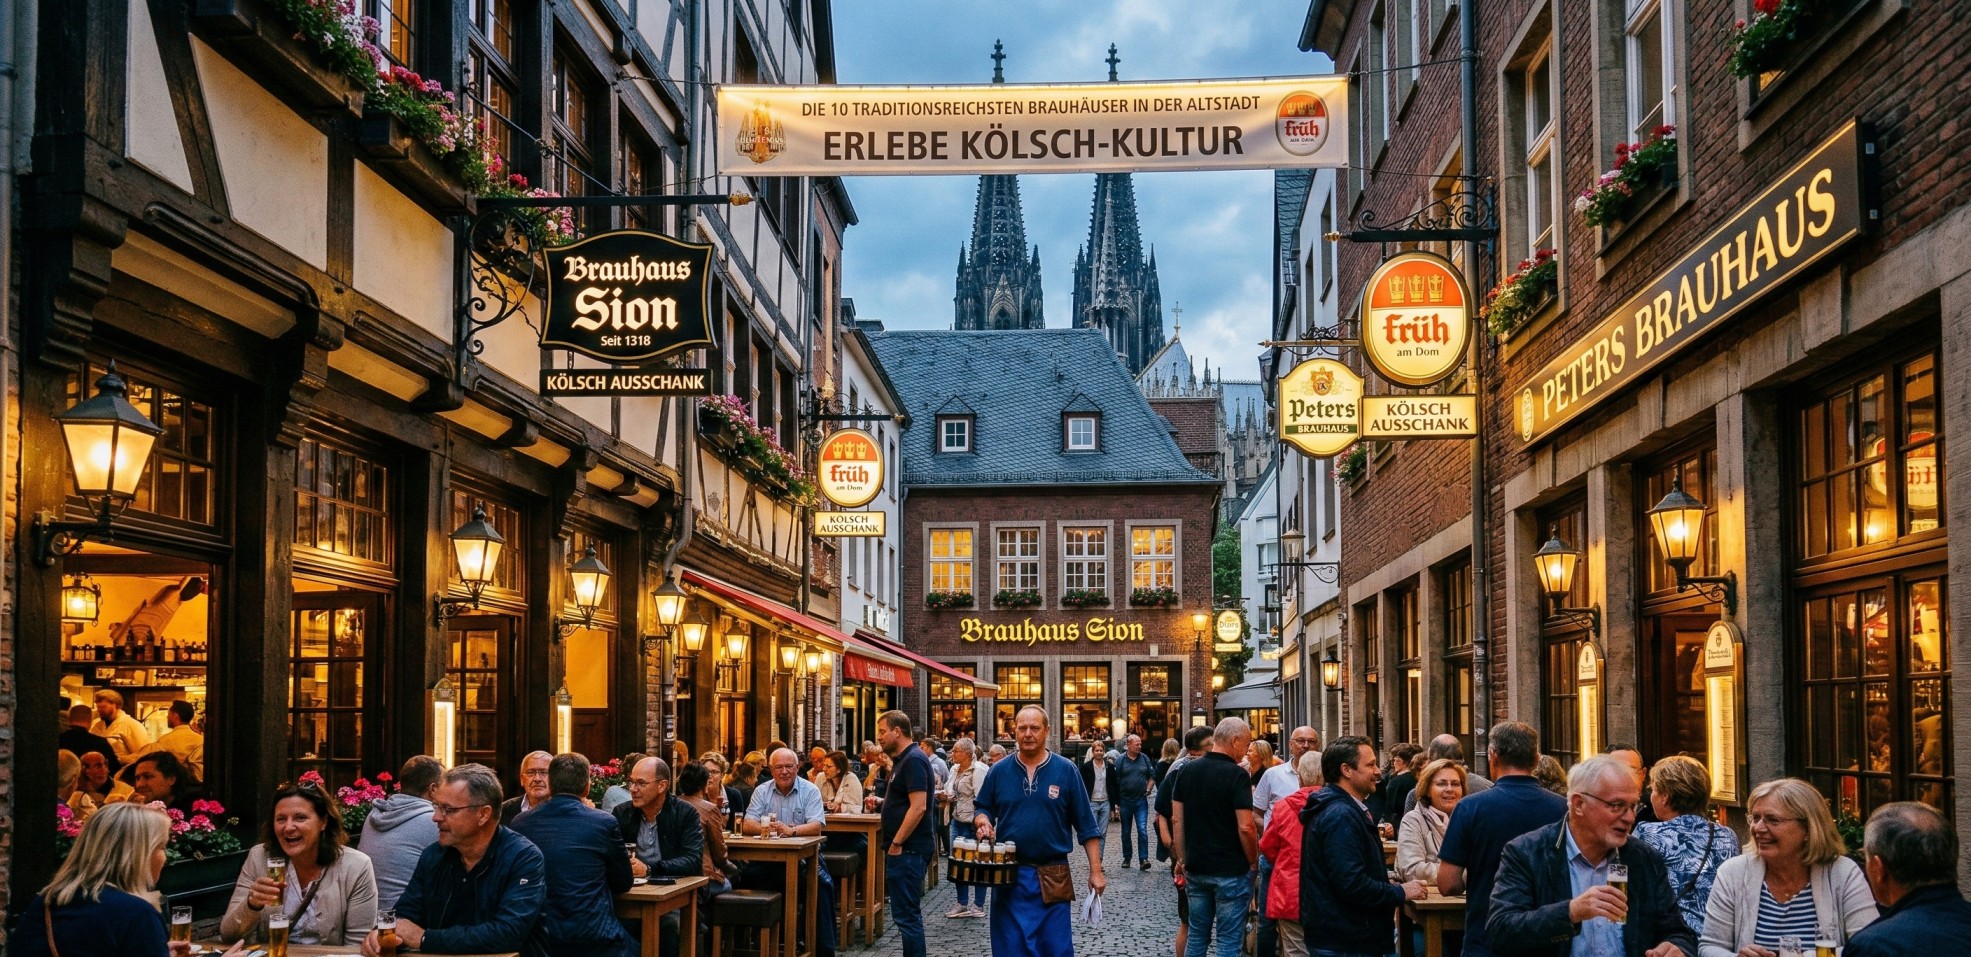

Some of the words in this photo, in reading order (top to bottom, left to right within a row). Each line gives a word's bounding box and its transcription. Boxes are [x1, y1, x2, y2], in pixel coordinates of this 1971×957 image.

[802, 102, 825, 116] DIE
[831, 102, 848, 116] 10
[852, 101, 1023, 116] TRADITIONSREICHSTEN
[1029, 96, 1128, 114] BRAUHÄUSER
[1133, 98, 1148, 113] IN
[1153, 97, 1182, 112] DER
[1187, 95, 1260, 112] ALTSTADT
[824, 131, 949, 161] ERLEBE
[961, 123, 1244, 160] KÖLSCH-KULTUR
[563, 255, 691, 286] Brauhaus
[1542, 325, 1626, 422] PETERS
[1635, 168, 1836, 359] BRAUHAUS
[571, 287, 679, 331] Sion
[1383, 313, 1450, 345] früh
[600, 335, 621, 346] Seit
[625, 335, 651, 346] 1318
[1396, 349, 1412, 357] am
[1415, 347, 1439, 356] Dom
[547, 373, 606, 390] KÖLSCH
[610, 375, 704, 390] AUSSCHANK
[1289, 399, 1356, 423] Peters
[1387, 401, 1451, 416] KÖLSCH
[1297, 424, 1349, 433] BRAUHAUS
[1370, 418, 1469, 432] AUSSCHANK
[829, 464, 869, 485] früh
[820, 525, 879, 533] AUSSCHANK
[960, 617, 1079, 647] Brauhaus
[1085, 617, 1145, 642] Sion
